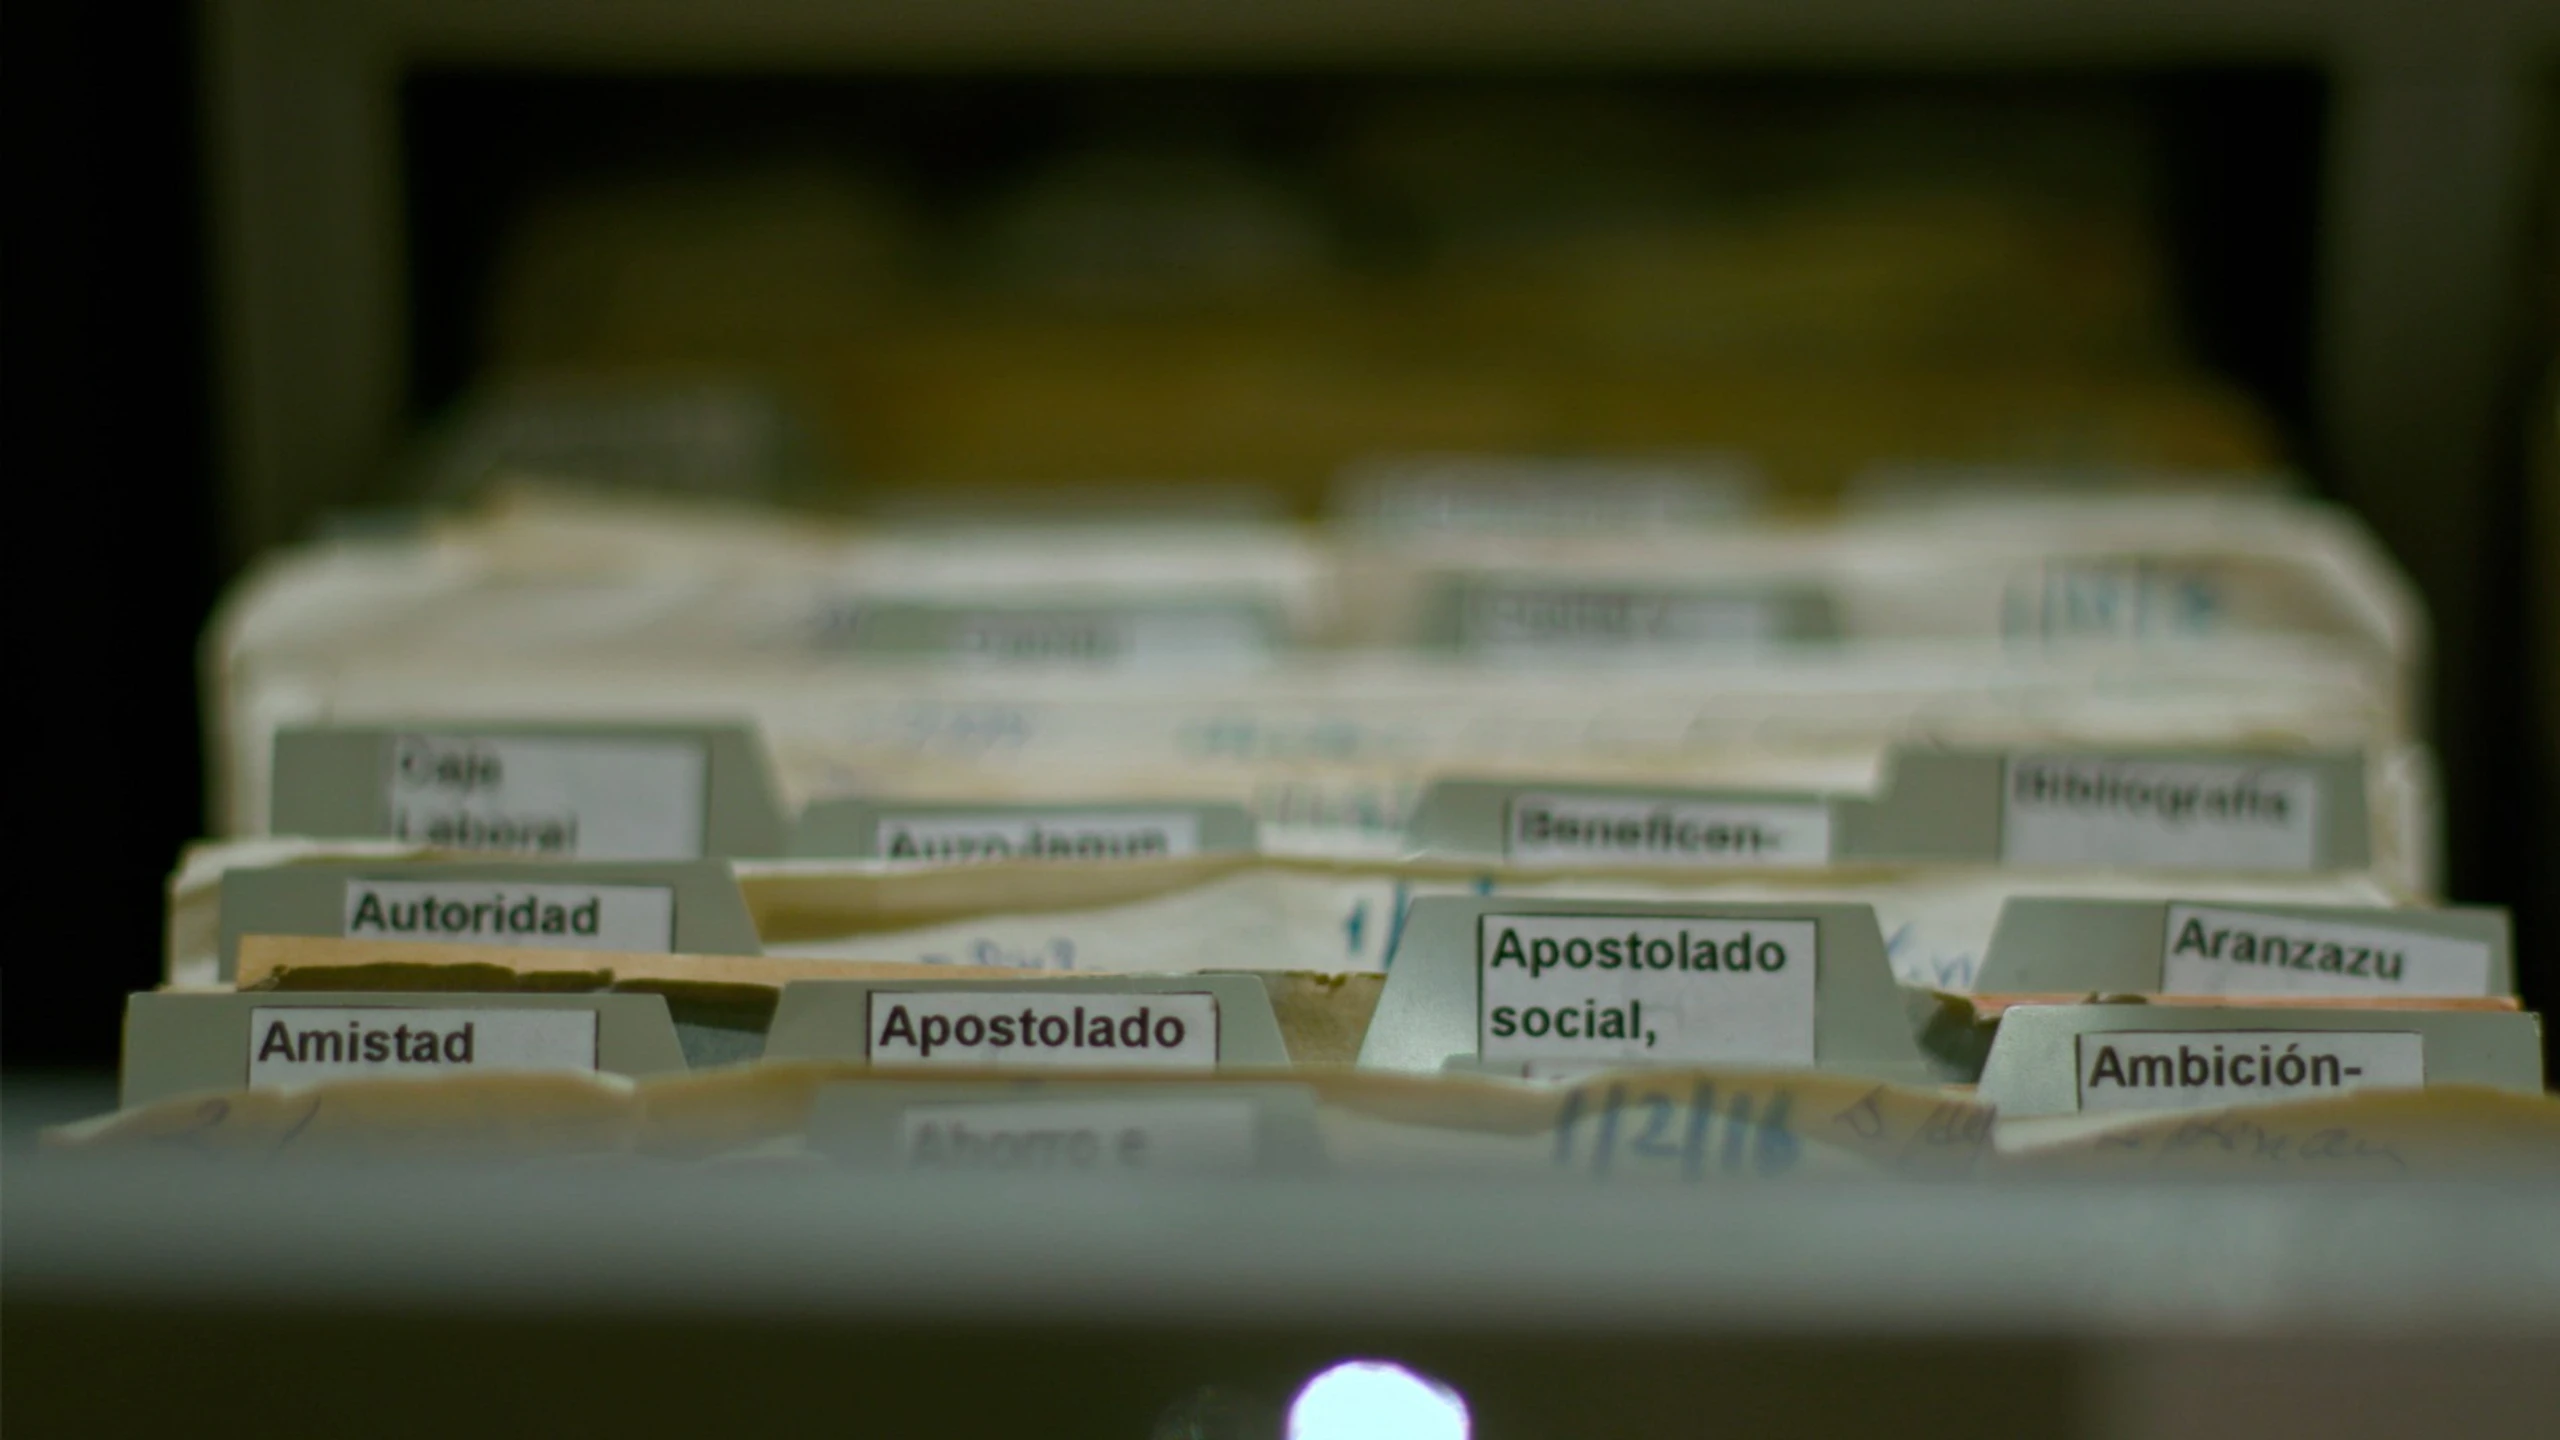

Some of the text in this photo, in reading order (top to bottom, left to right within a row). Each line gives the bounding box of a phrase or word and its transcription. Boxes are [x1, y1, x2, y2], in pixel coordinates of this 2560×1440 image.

[350, 892, 600, 938] Autoridad
[1490, 927, 1787, 978] Apostolado
[2173, 916, 2405, 982] Aranzazu
[257, 1021, 475, 1065] Amistad
[878, 1004, 1186, 1056] Apostolado
[1490, 1001, 1657, 1048] social,
[2088, 1043, 2363, 1089] Ambición-
